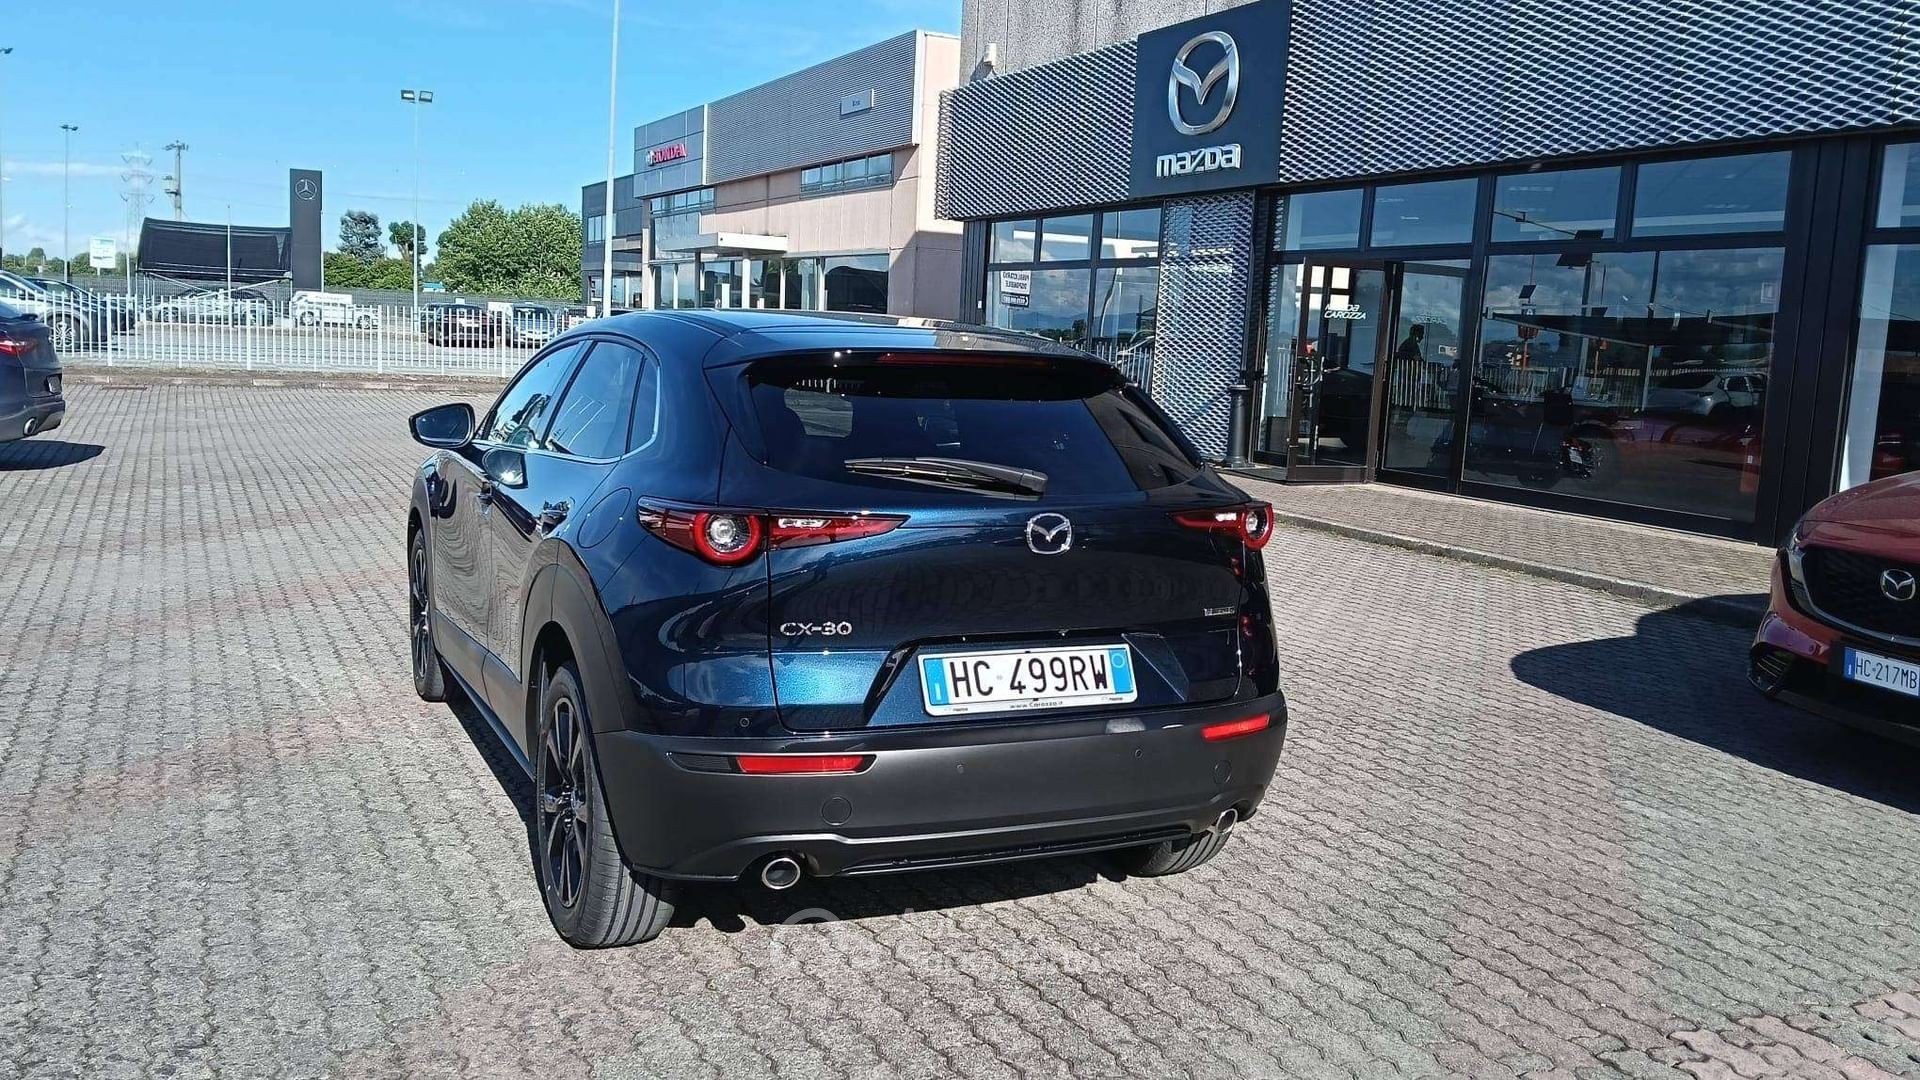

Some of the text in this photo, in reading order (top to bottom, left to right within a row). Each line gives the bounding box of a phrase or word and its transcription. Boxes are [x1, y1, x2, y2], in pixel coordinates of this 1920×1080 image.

[1323, 310, 1366, 320] CAROZZA
[780, 621, 852, 636] CX-30
[950, 660, 993, 698] HC
[1009, 654, 1109, 694] 499RW
[1855, 656, 1871, 677] HC
[1875, 662, 1918, 689] 217MB
